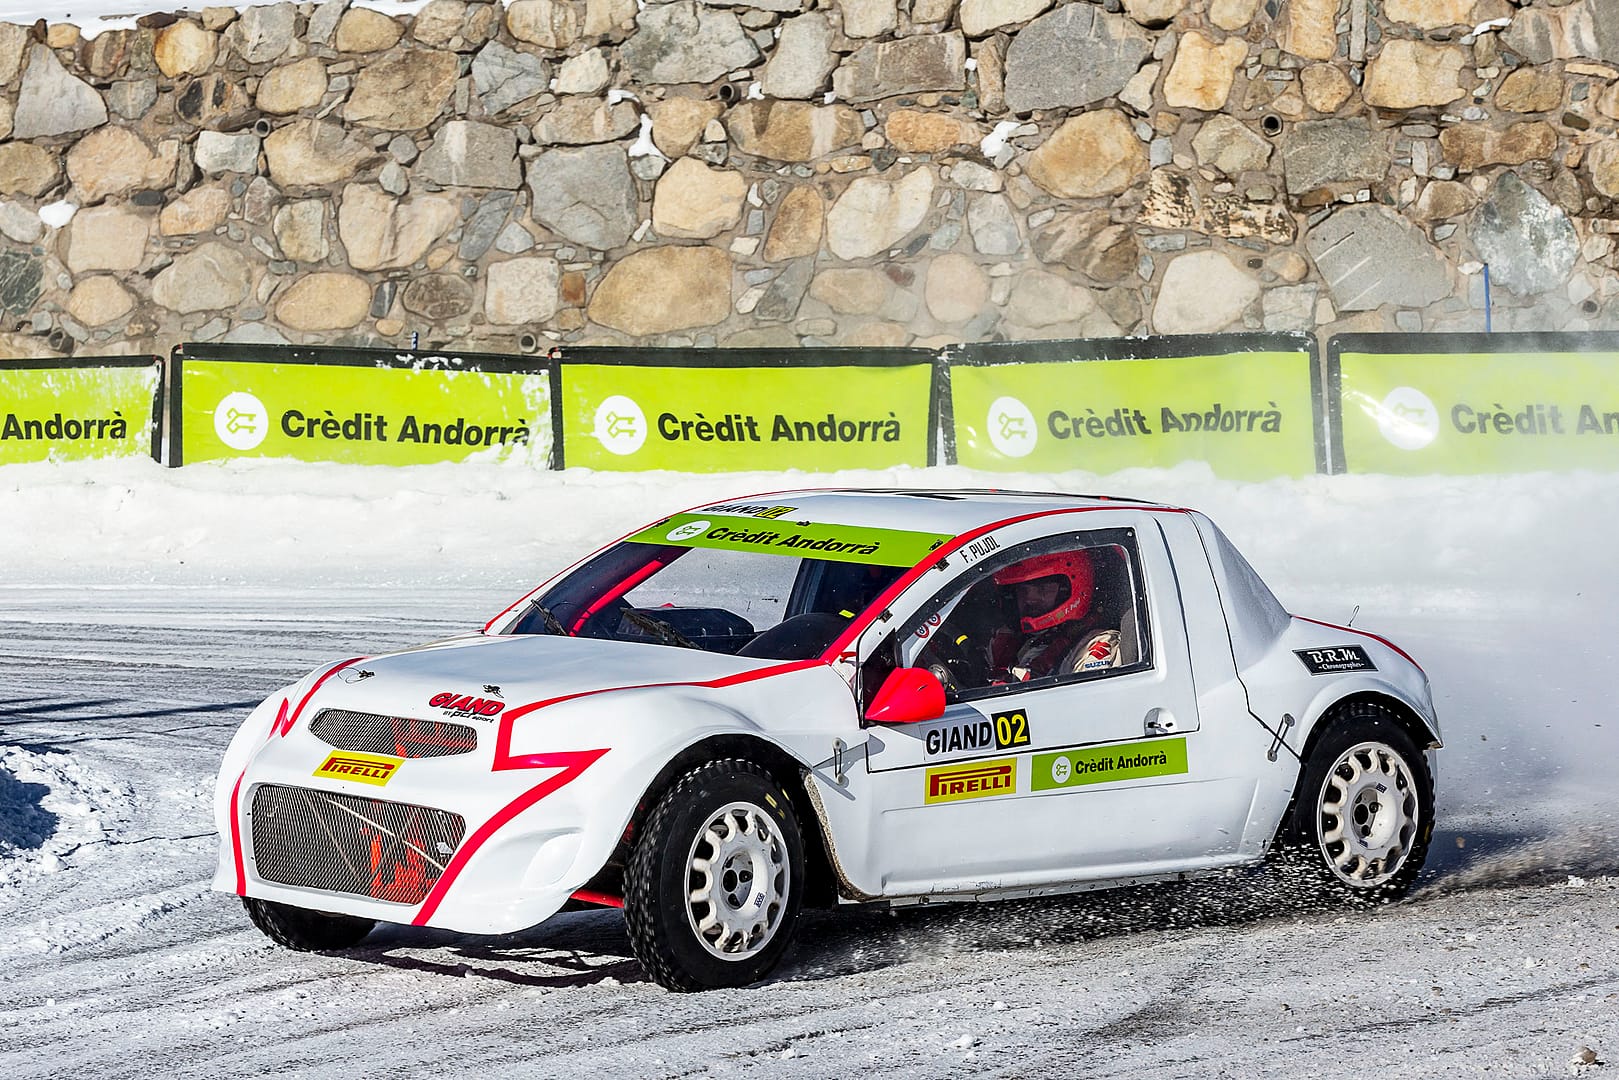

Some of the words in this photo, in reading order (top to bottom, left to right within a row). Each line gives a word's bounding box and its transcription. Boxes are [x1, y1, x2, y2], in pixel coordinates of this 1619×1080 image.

[1, 411, 127, 440] Andorrà
[281, 409, 387, 441] Crèdit
[397, 416, 530, 446] Andorrà
[657, 412, 761, 442] Crèdit
[771, 411, 900, 442] Andorrà
[1048, 408, 1152, 439] Crèdit
[1161, 401, 1282, 433] Andorrà
[1450, 403, 1566, 435] Crèdit
[706, 527, 780, 545] Crèdit
[775, 535, 880, 555] Andorrà
[960, 549, 973, 563] F.
[969, 535, 1001, 559] PUJOL
[428, 692, 506, 716] GIAND
[926, 721, 993, 756] GIAND
[996, 713, 1028, 746] 02
[321, 757, 395, 779] PIRELLI
[1075, 757, 1115, 775] Crèdit
[1116, 750, 1167, 770] Andorrà
[929, 765, 1012, 797] PIRELLI
